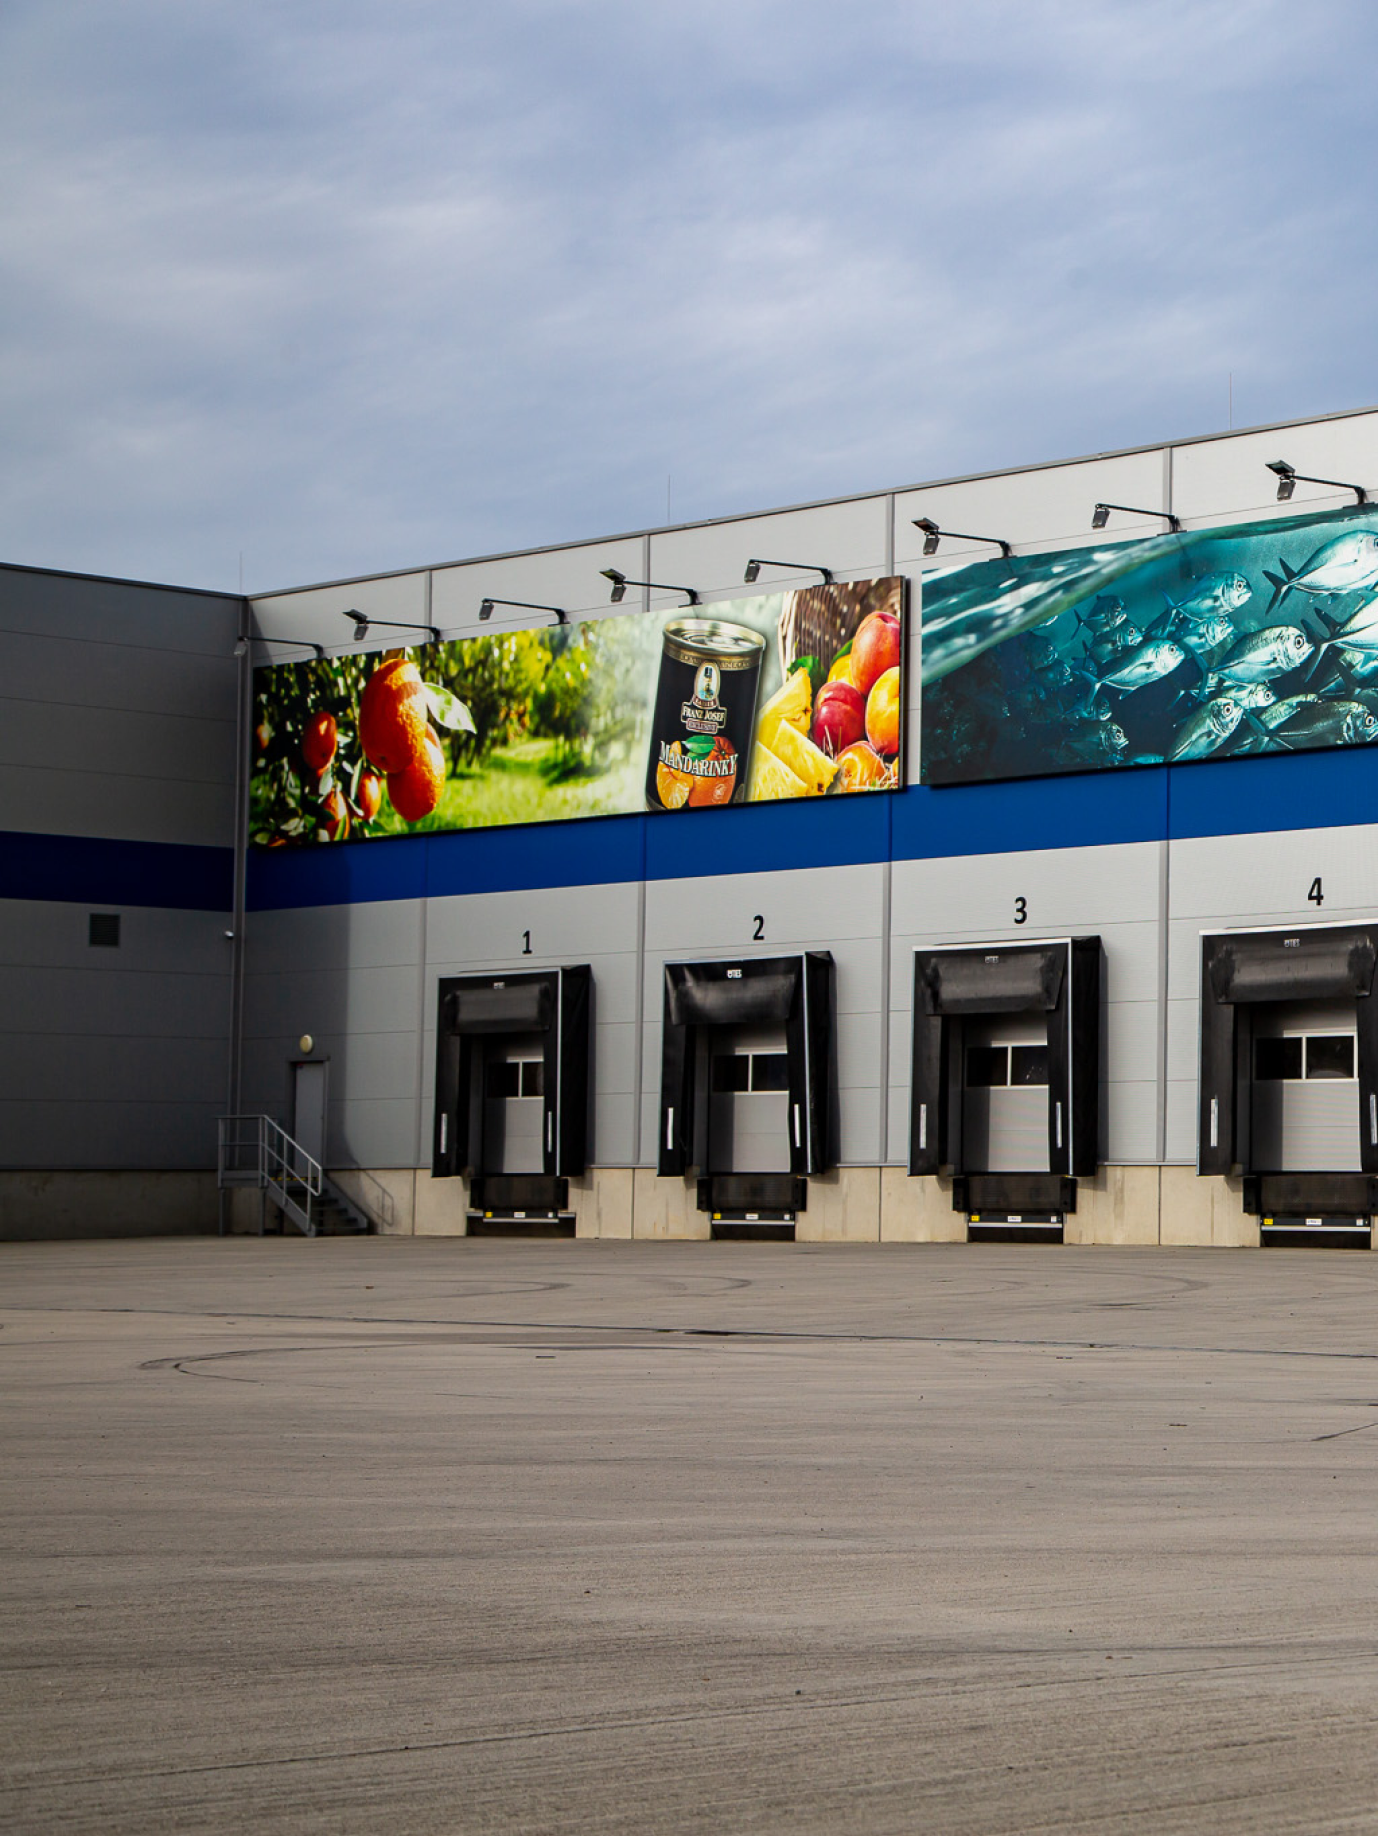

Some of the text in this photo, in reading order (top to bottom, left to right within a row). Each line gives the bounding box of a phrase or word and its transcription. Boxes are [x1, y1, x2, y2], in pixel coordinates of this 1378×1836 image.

[682, 705, 725, 722] FRANZ JOSEF
[658, 740, 739, 777] MANDARINKY
[1307, 876, 1324, 906] 4
[1013, 896, 1028, 924] 3
[752, 914, 765, 941] 2
[522, 930, 533, 955] 1
